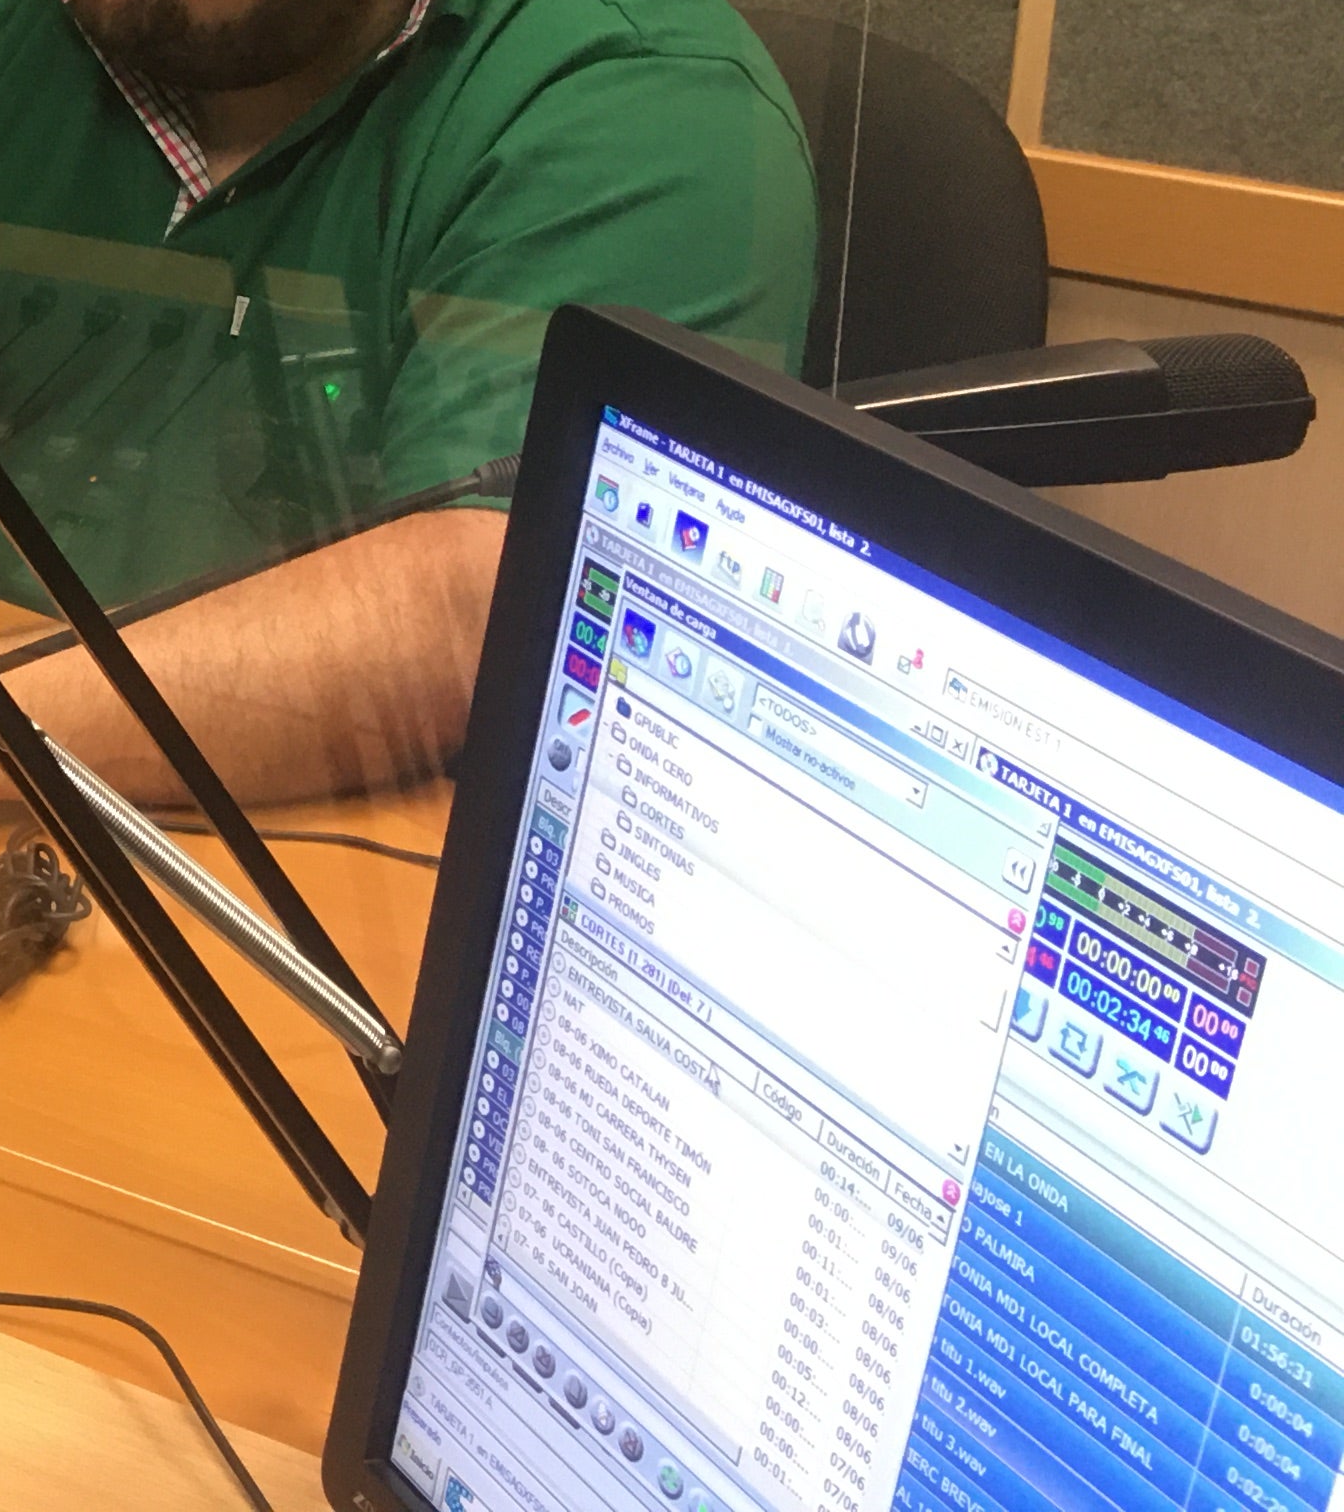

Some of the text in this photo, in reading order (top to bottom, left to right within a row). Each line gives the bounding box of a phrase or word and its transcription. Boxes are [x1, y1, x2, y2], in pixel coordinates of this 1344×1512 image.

[619, 414, 855, 548] XFrame TARJETA 1 en lista
[668, 472, 706, 503] Ventana
[624, 575, 717, 641] Ventana de carga
[629, 737, 693, 786] ONDA CERO
[634, 712, 680, 750] GPUBLIC
[766, 723, 802, 758] Mostrar
[634, 768, 719, 834] INFORMATIVOS
[640, 802, 686, 840] CORTES
[619, 843, 662, 882] JINGLES
[635, 826, 695, 877] SINTONIAS
[1002, 765, 1239, 916] TARJETA 1 en lista
[609, 893, 655, 935] PROMOS
[613, 868, 656, 906] MUSICA
[581, 914, 625, 956] CORTES
[563, 990, 586, 1014] NAT
[568, 966, 672, 1056] ENTREVISTA SALVA
[553, 1039, 583, 1070] 08-06
[584, 1063, 620, 1101] RUEDA
[621, 1094, 672, 1144] DEPORTE
[558, 1015, 670, 1112] 08-06 XIMO CATALAN
[562, 929, 933, 1221] Descripción Código Duración Fecha
[543, 1087, 691, 1217] 08-06 TONI SAN FRANCISCO
[548, 1063, 578, 1095] 08-06
[596, 1102, 646, 1152] CARRERA
[648, 1143, 692, 1189] THYSEN
[538, 1111, 699, 1255] 08-06 CENTRO SOCIAL BALDRE
[567, 1163, 612, 1210] SOTOCA
[613, 1203, 647, 1239] NOOO
[984, 1141, 1070, 1214] EN LA ONDA
[527, 1158, 659, 1279] ENTREVISTA JUAN PEDRO
[547, 1260, 598, 1314] SAN JOAN
[552, 1235, 612, 1299] UCRANIANA
[613, 1290, 653, 1337] (Copia)
[557, 1212, 649, 1303] CASTILLO (Copia)
[974, 1226, 1035, 1284] PALMIRA
[1252, 1286, 1322, 1346] Duración
[940, 1338, 1007, 1399] titu 1.wav
[996, 1289, 1159, 1425] MD1 LOCAL COMPLETA
[931, 1376, 997, 1438] titu 2.wav
[986, 1328, 1153, 1471] MD1 LOCAL PARA FINAL
[922, 1414, 987, 1477] titu 3.wav
